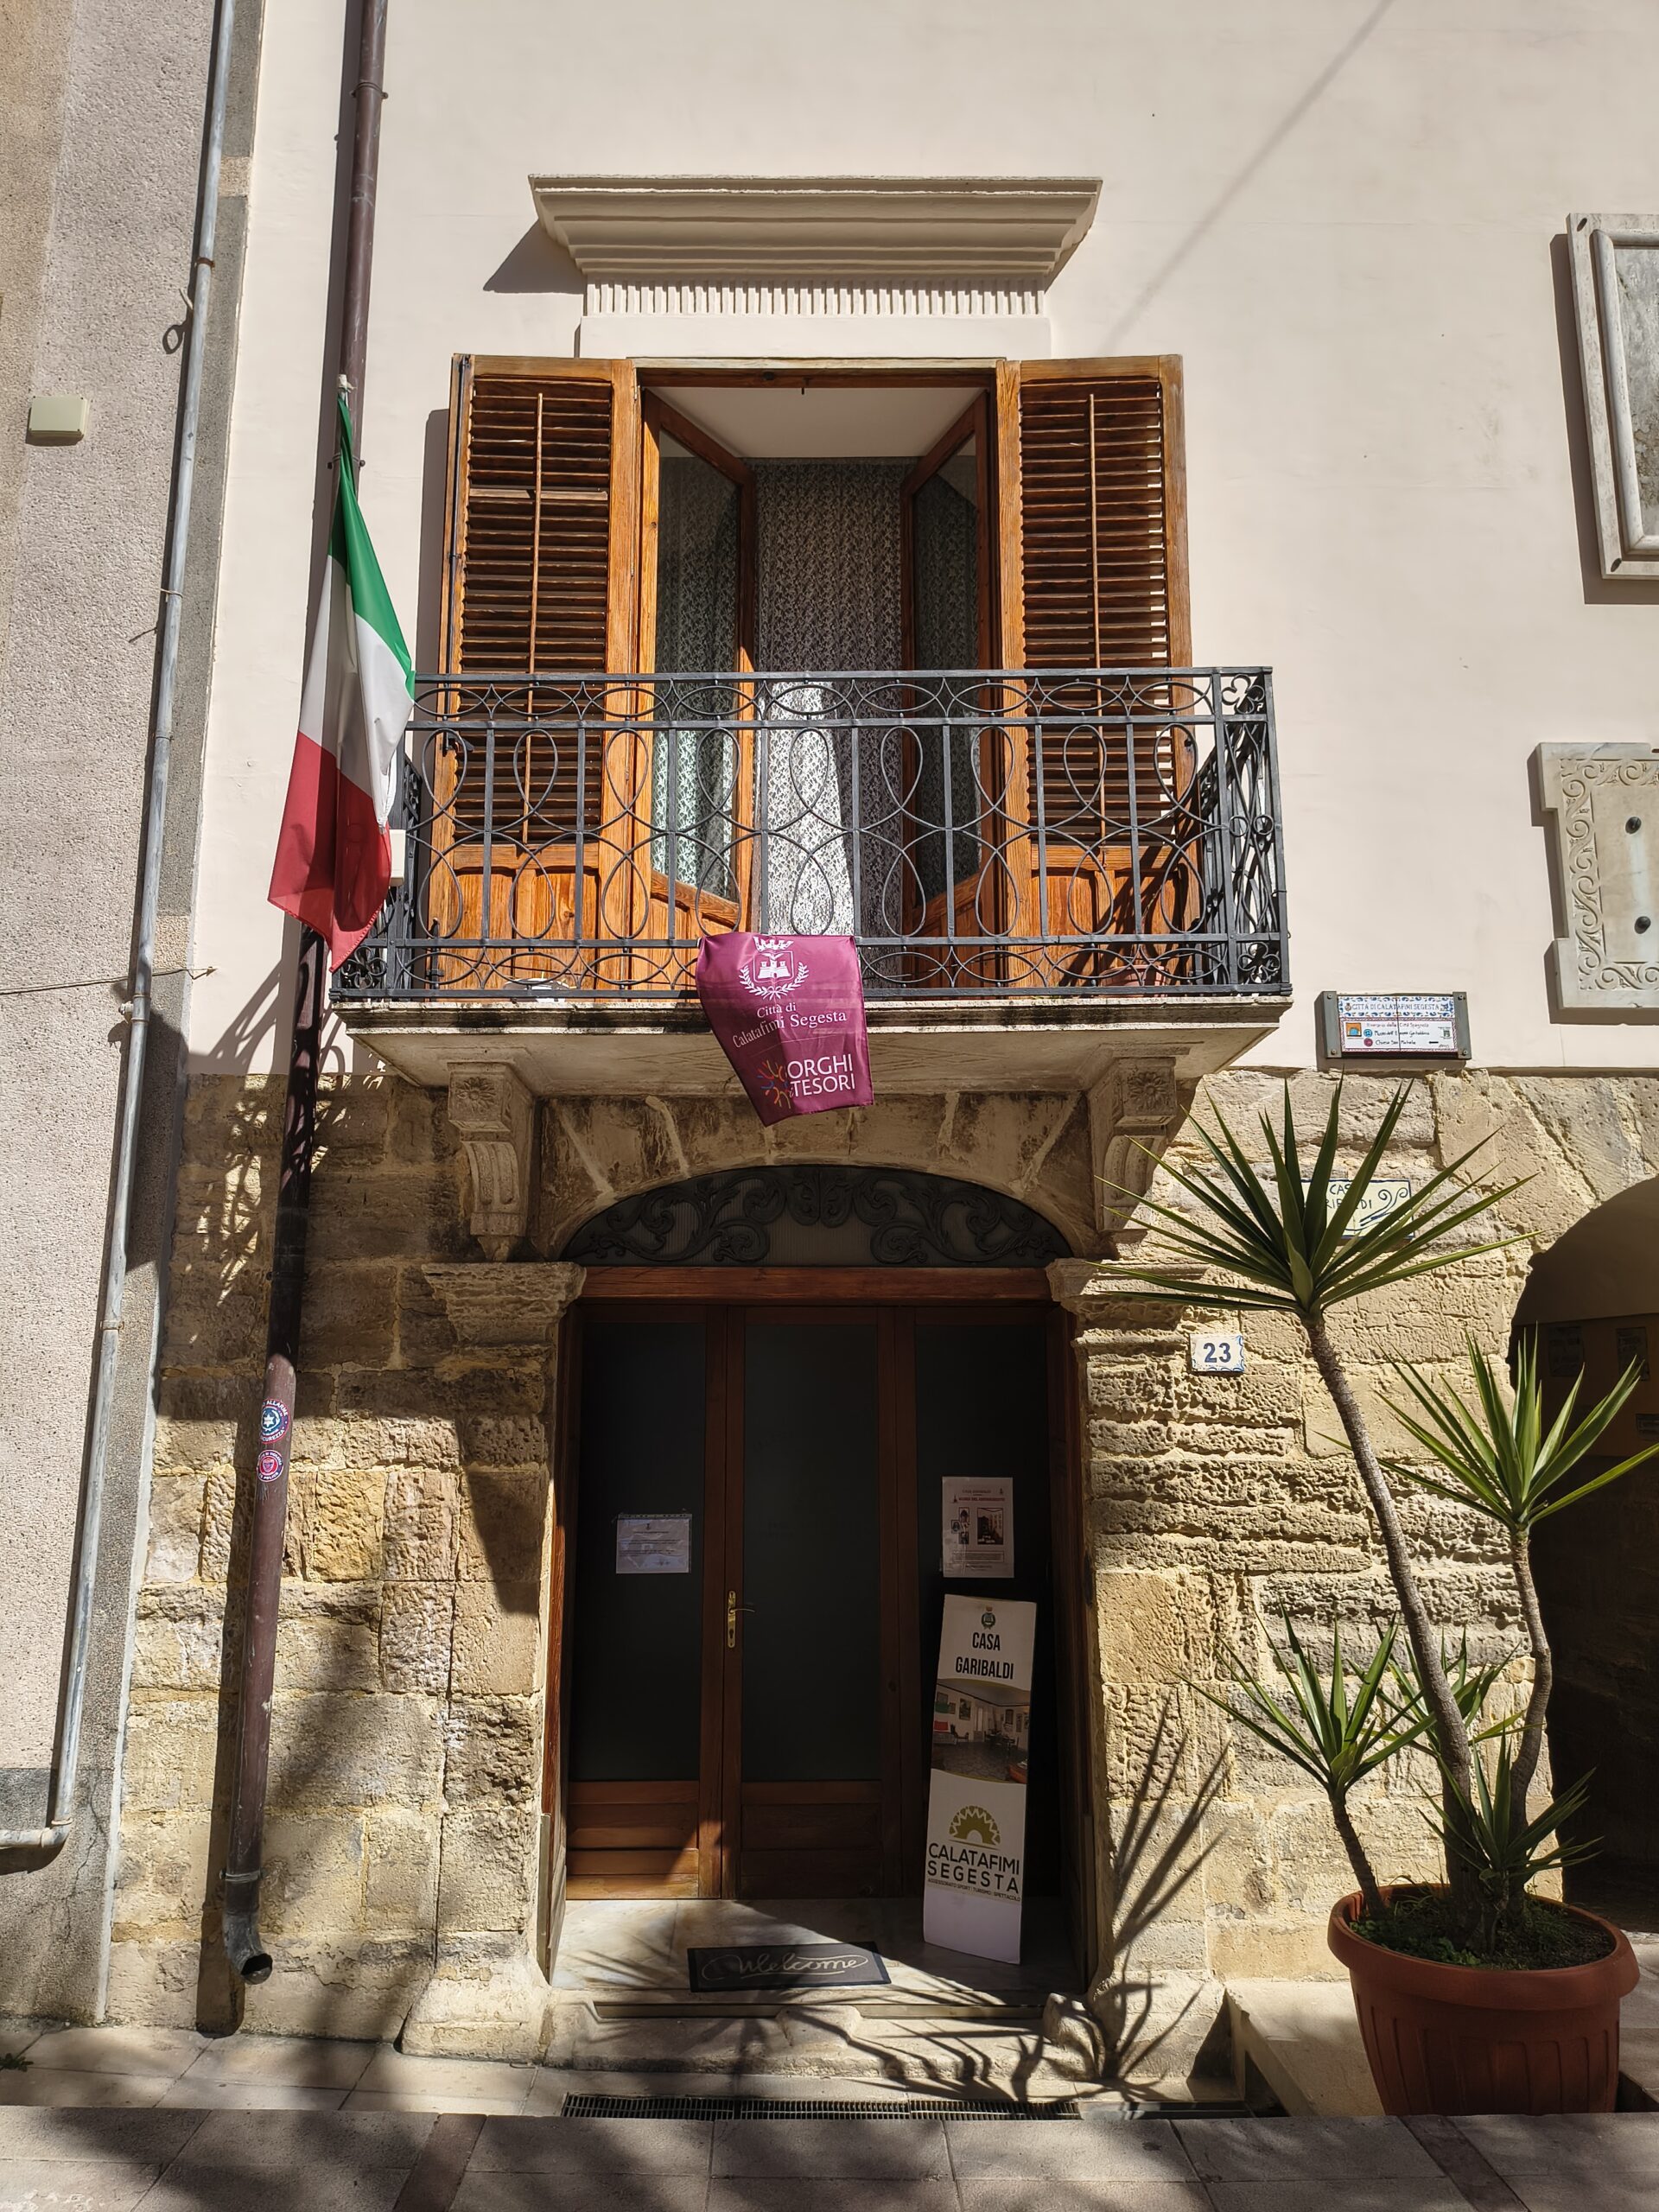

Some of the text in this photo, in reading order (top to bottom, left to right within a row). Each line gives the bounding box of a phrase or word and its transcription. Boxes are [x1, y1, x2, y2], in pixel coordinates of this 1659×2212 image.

[757, 1002, 797, 1019] Città di
[733, 1011, 847, 1048] Calatafimi Segesta
[785, 1053, 853, 1079] ORGHI
[790, 1073, 855, 1097] TESORI
[1203, 1342, 1231, 1363] 23
[972, 1632, 1001, 1651] CASA
[956, 1656, 1014, 1680] GARIBALDI
[928, 1843, 1020, 1875] CALATAFIMI
[927, 1860, 1019, 1894] SEGESTA
[702, 1952, 868, 1980] Welcome
